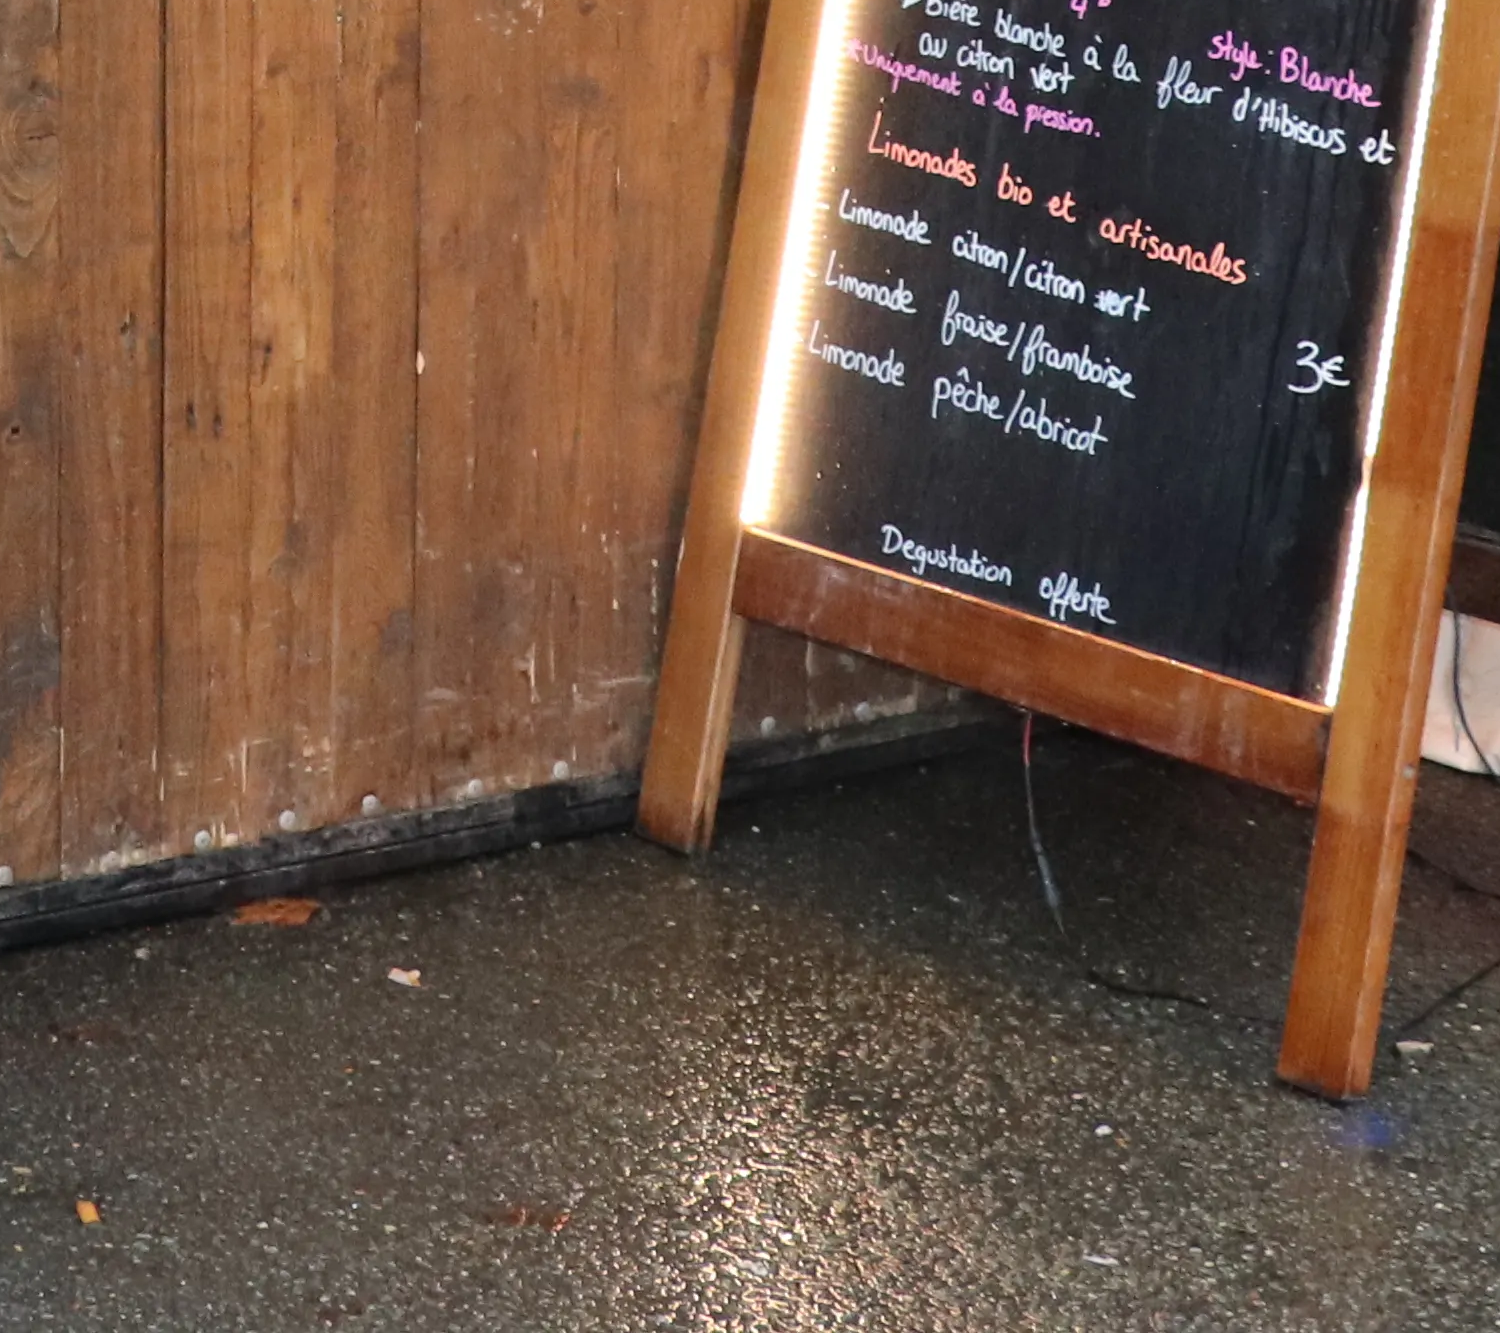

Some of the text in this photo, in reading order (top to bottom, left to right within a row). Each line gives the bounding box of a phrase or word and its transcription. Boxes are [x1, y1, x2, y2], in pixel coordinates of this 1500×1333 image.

[918, 32, 1076, 95] au citron vert
[993, 8, 1068, 59] blanche
[1083, 33, 1104, 72] à
[1112, 42, 1143, 84] la
[1155, 55, 1225, 111] fleur
[1358, 128, 1398, 166] et
[1279, 46, 1382, 108] Blanche
[838, 188, 932, 247] Limonade
[866, 108, 1249, 286] Limonades bio et artisanales
[823, 249, 917, 315] Limonade
[807, 318, 906, 388] Limonade
[1287, 339, 1352, 396] 3€
[1037, 570, 1118, 626] offerte
